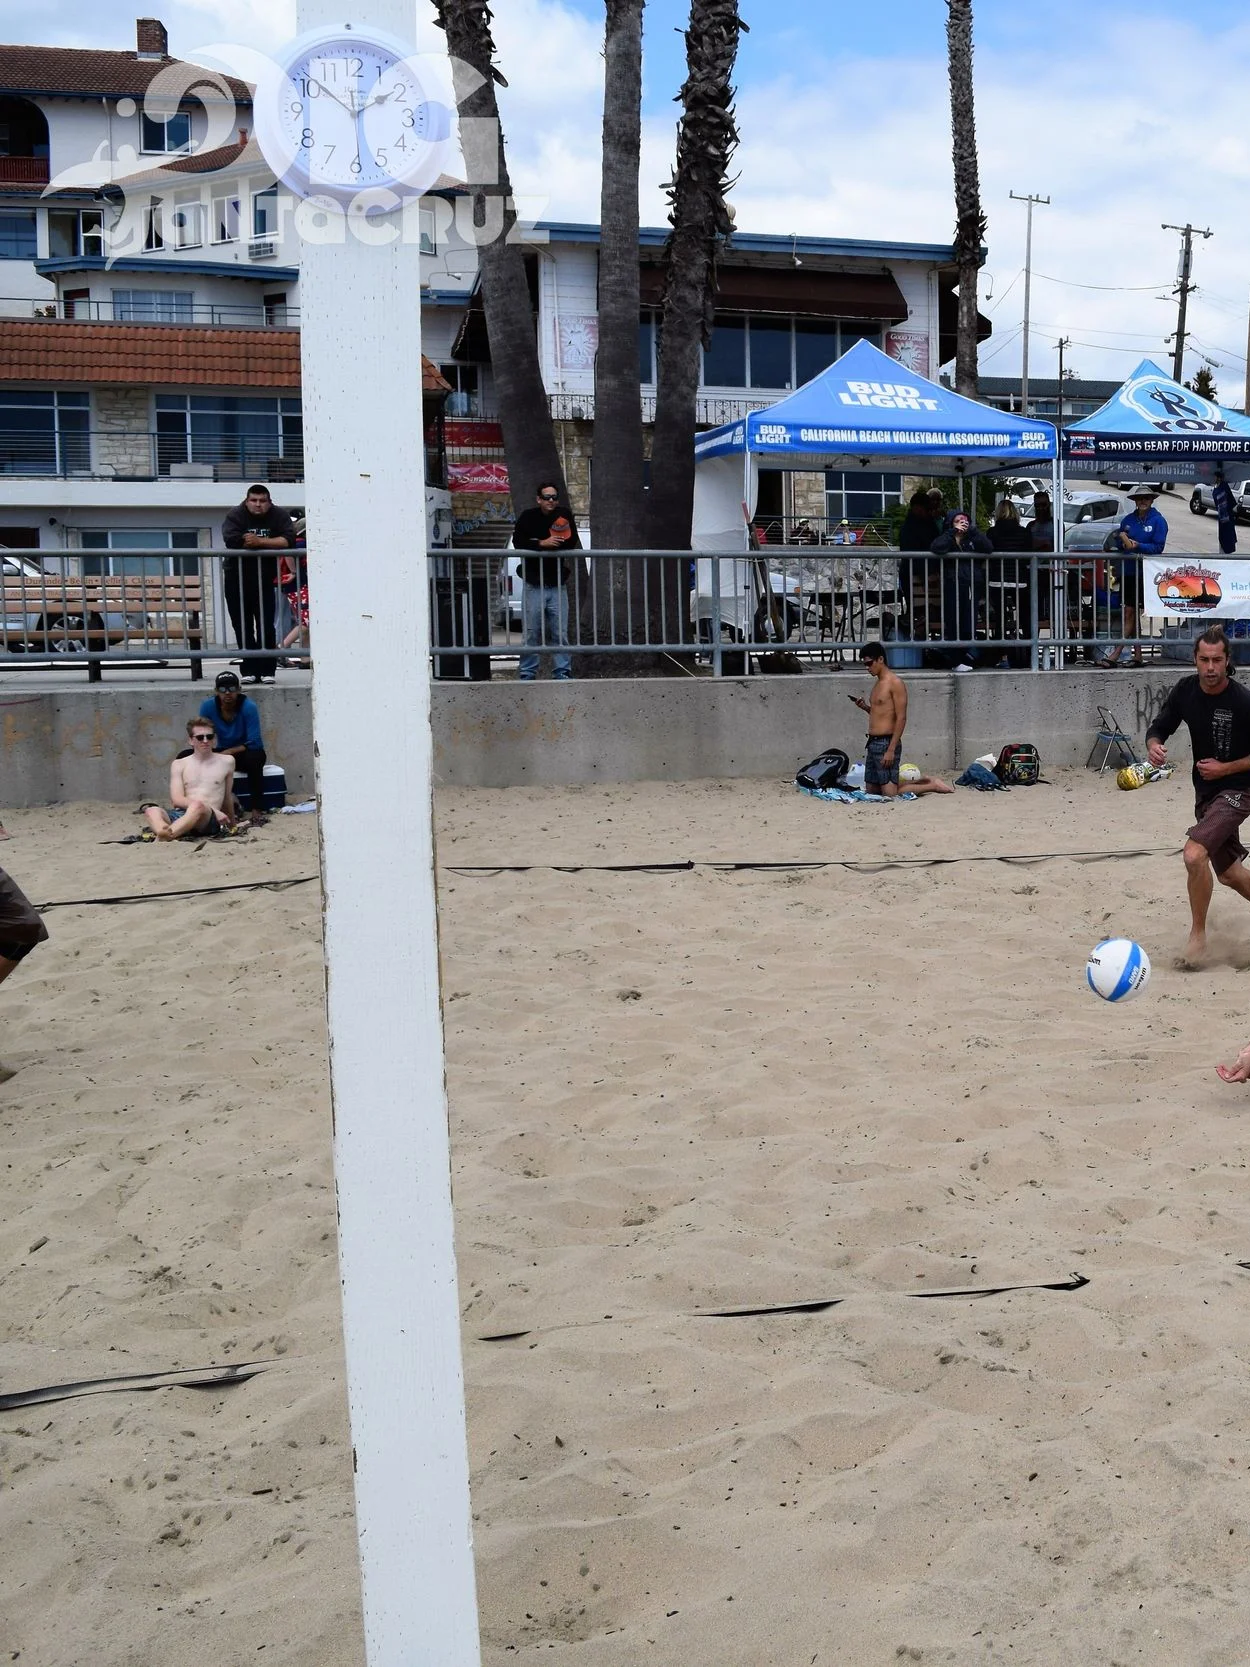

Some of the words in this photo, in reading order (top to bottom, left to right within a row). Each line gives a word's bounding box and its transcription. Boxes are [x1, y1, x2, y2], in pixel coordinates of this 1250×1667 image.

[321, 62, 337, 82] 11
[344, 58, 364, 78] 12
[375, 65, 382, 85] 1
[299, 78, 321, 98] 10
[393, 83, 407, 103] 2
[290, 101, 304, 121] 9
[401, 108, 415, 128] 3
[301, 128, 315, 149] 8
[393, 133, 407, 152] 4
[323, 144, 337, 165] 7
[350, 154, 363, 174] 6
[374, 148, 388, 168] 5
[846, 381, 920, 398] BUD
[838, 393, 938, 411] LIGHT
[755, 434, 791, 444] LIGHT
[760, 425, 786, 434] BUD
[801, 429, 858, 443] CALIFORNIA
[859, 430, 890, 444] BEACH
[892, 431, 948, 445] VOLLEYBALL
[949, 432, 1010, 447] ASSOCIATION
[1022, 432, 1046, 441] BUD
[1017, 440, 1049, 450] LIGHT
[1098, 441, 1142, 451] SERIOUS
[1144, 441, 1169, 451] GEAR
[1171, 441, 1190, 452] FOR
[1192, 441, 1242, 453] HARDCORE
